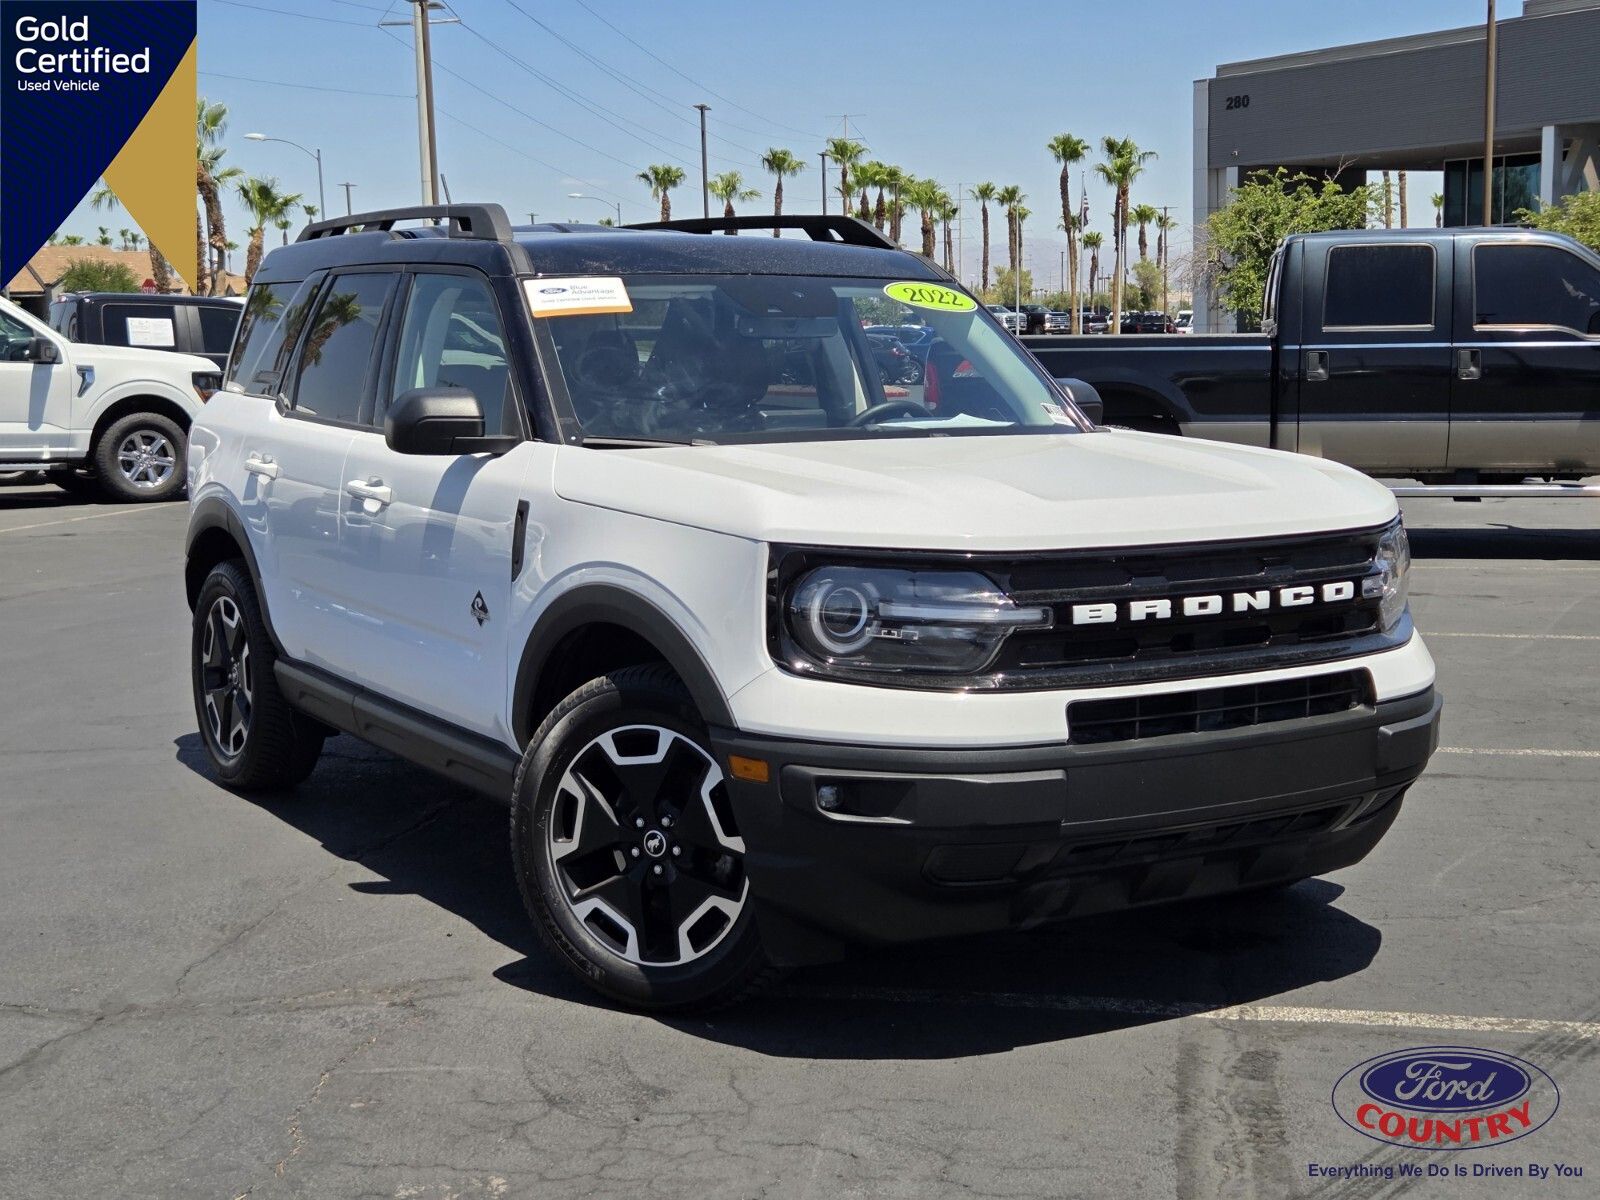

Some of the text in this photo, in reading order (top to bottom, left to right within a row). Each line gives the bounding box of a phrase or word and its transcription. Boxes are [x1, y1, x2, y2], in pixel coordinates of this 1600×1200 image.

[1226, 95, 1250, 110] 280
[903, 287, 964, 307] 2022
[1072, 581, 1355, 625] BRONCO
